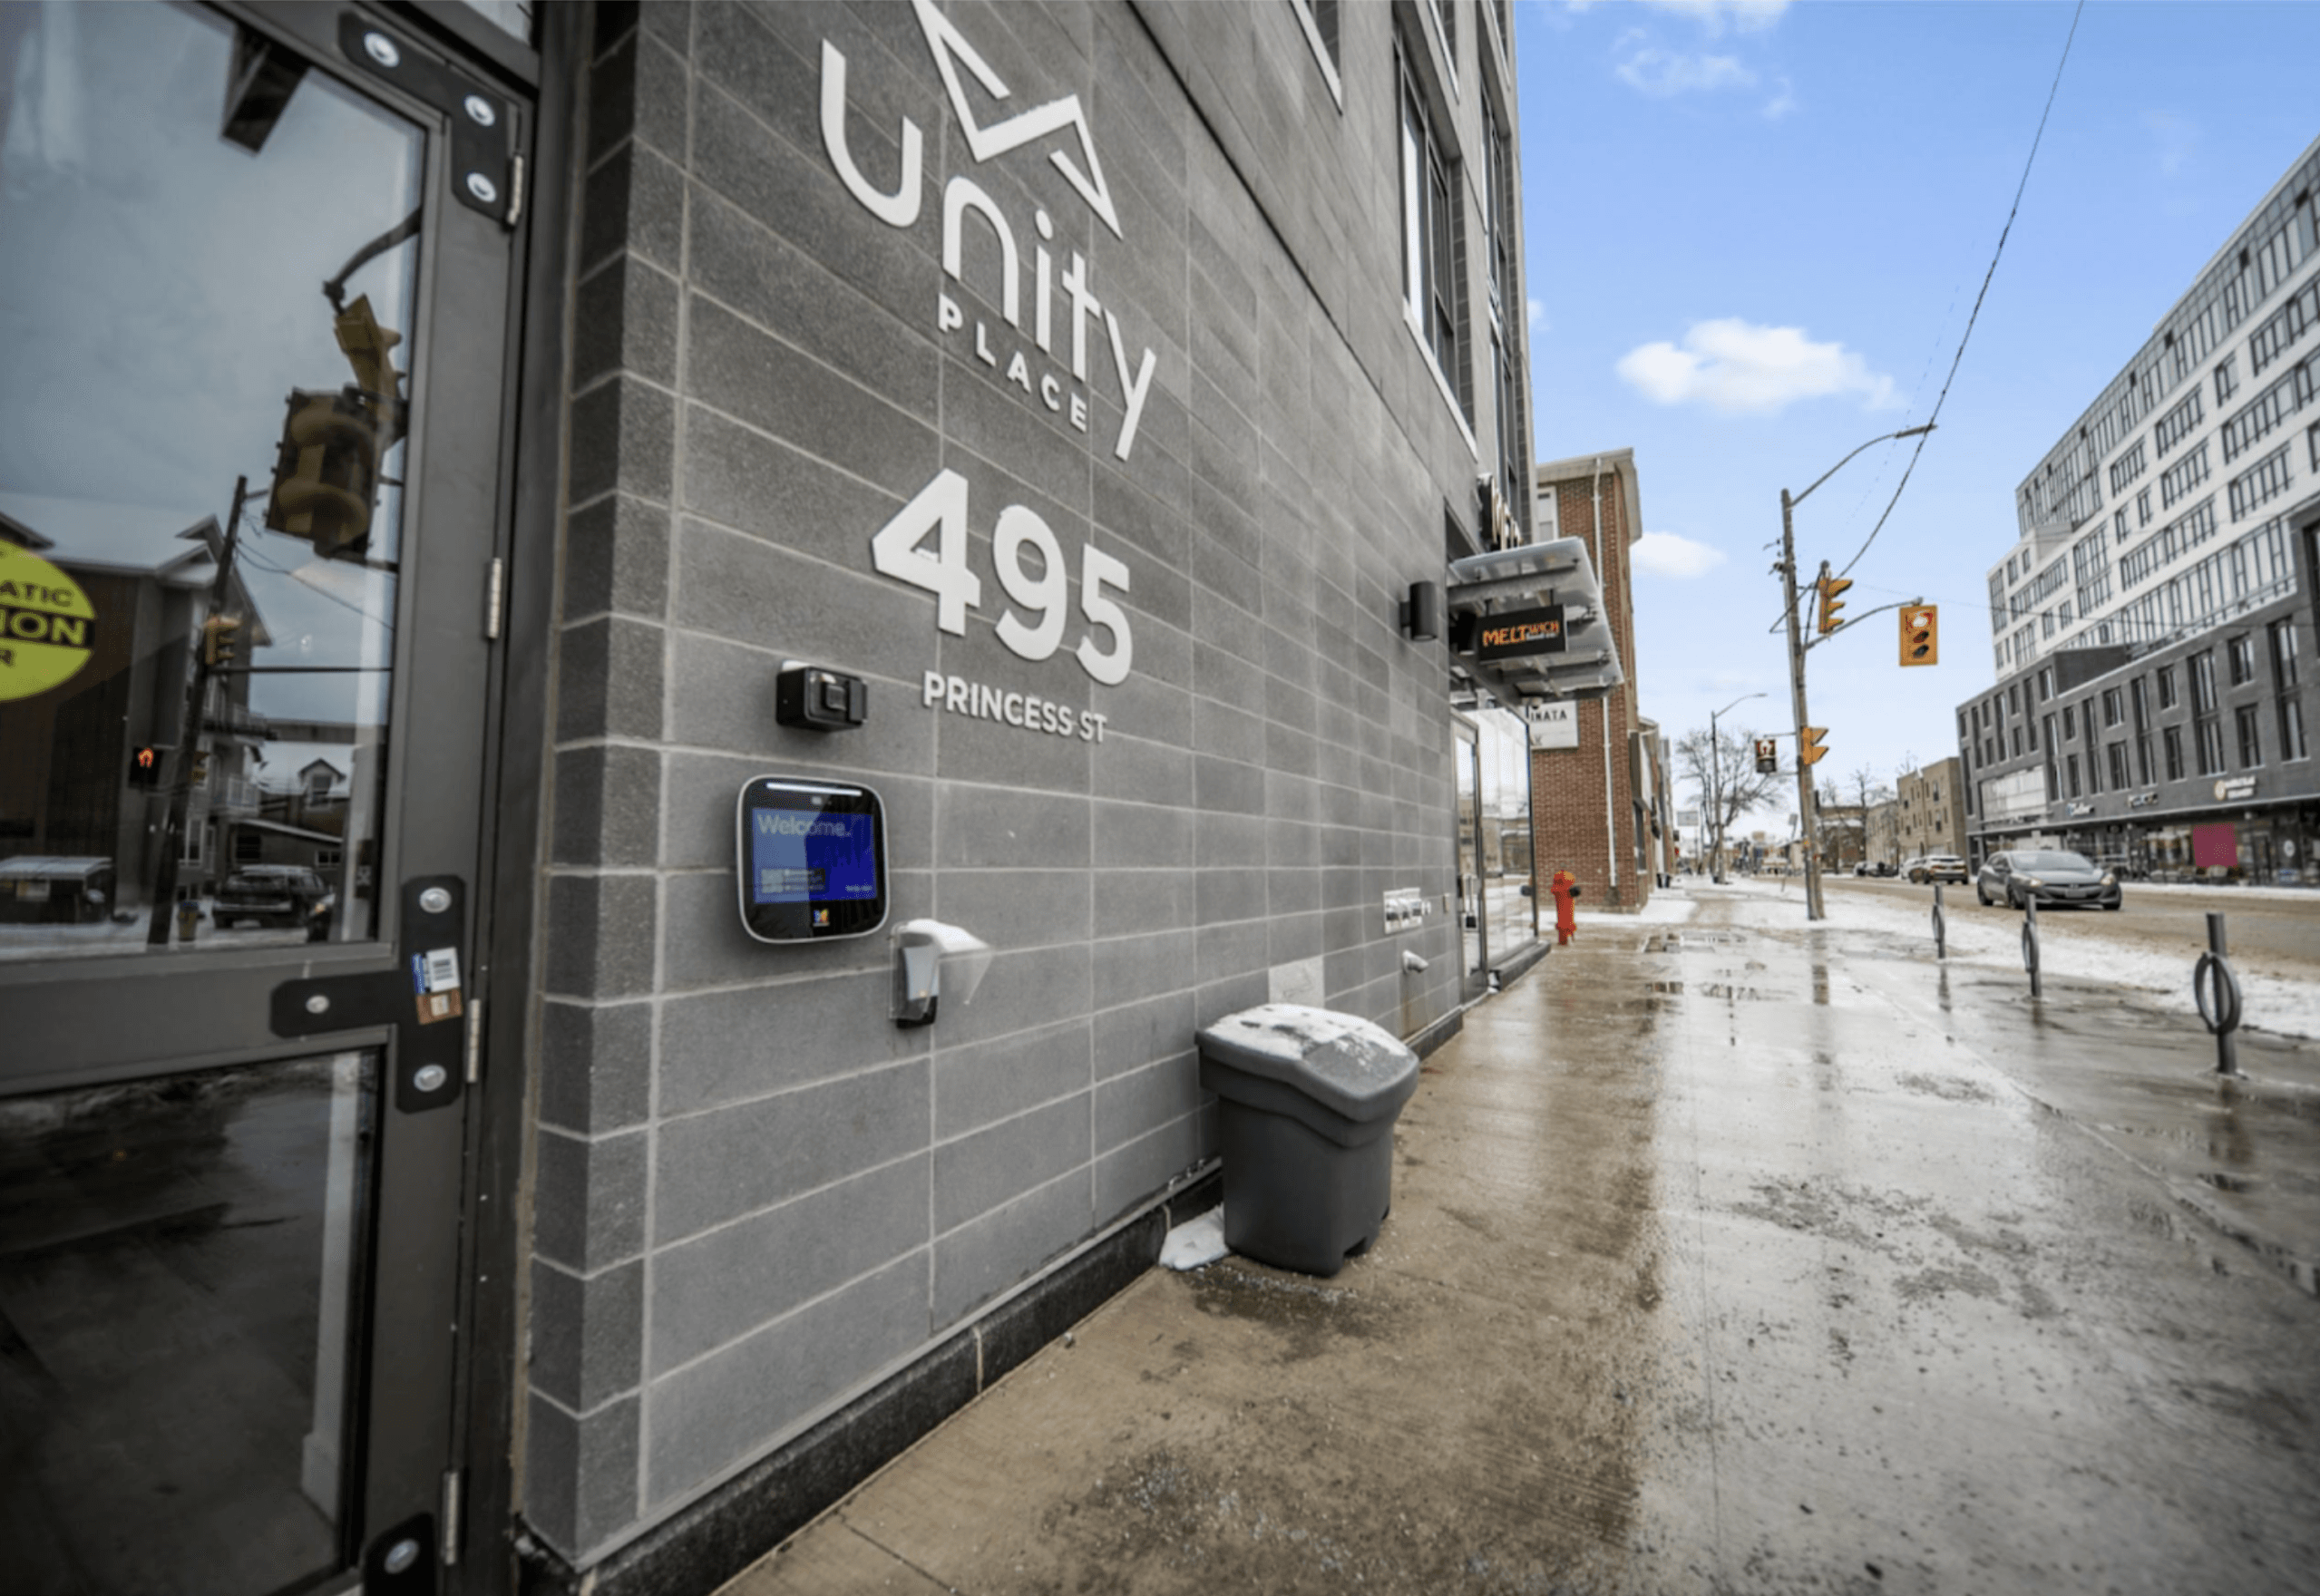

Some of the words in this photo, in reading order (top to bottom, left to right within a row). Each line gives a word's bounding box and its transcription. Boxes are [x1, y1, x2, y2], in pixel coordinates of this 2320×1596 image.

[938, 292, 1087, 433] PLACE
[871, 467, 1133, 686] 495
[923, 670, 1072, 736] PRINCESS
[1078, 711, 1107, 743] ST
